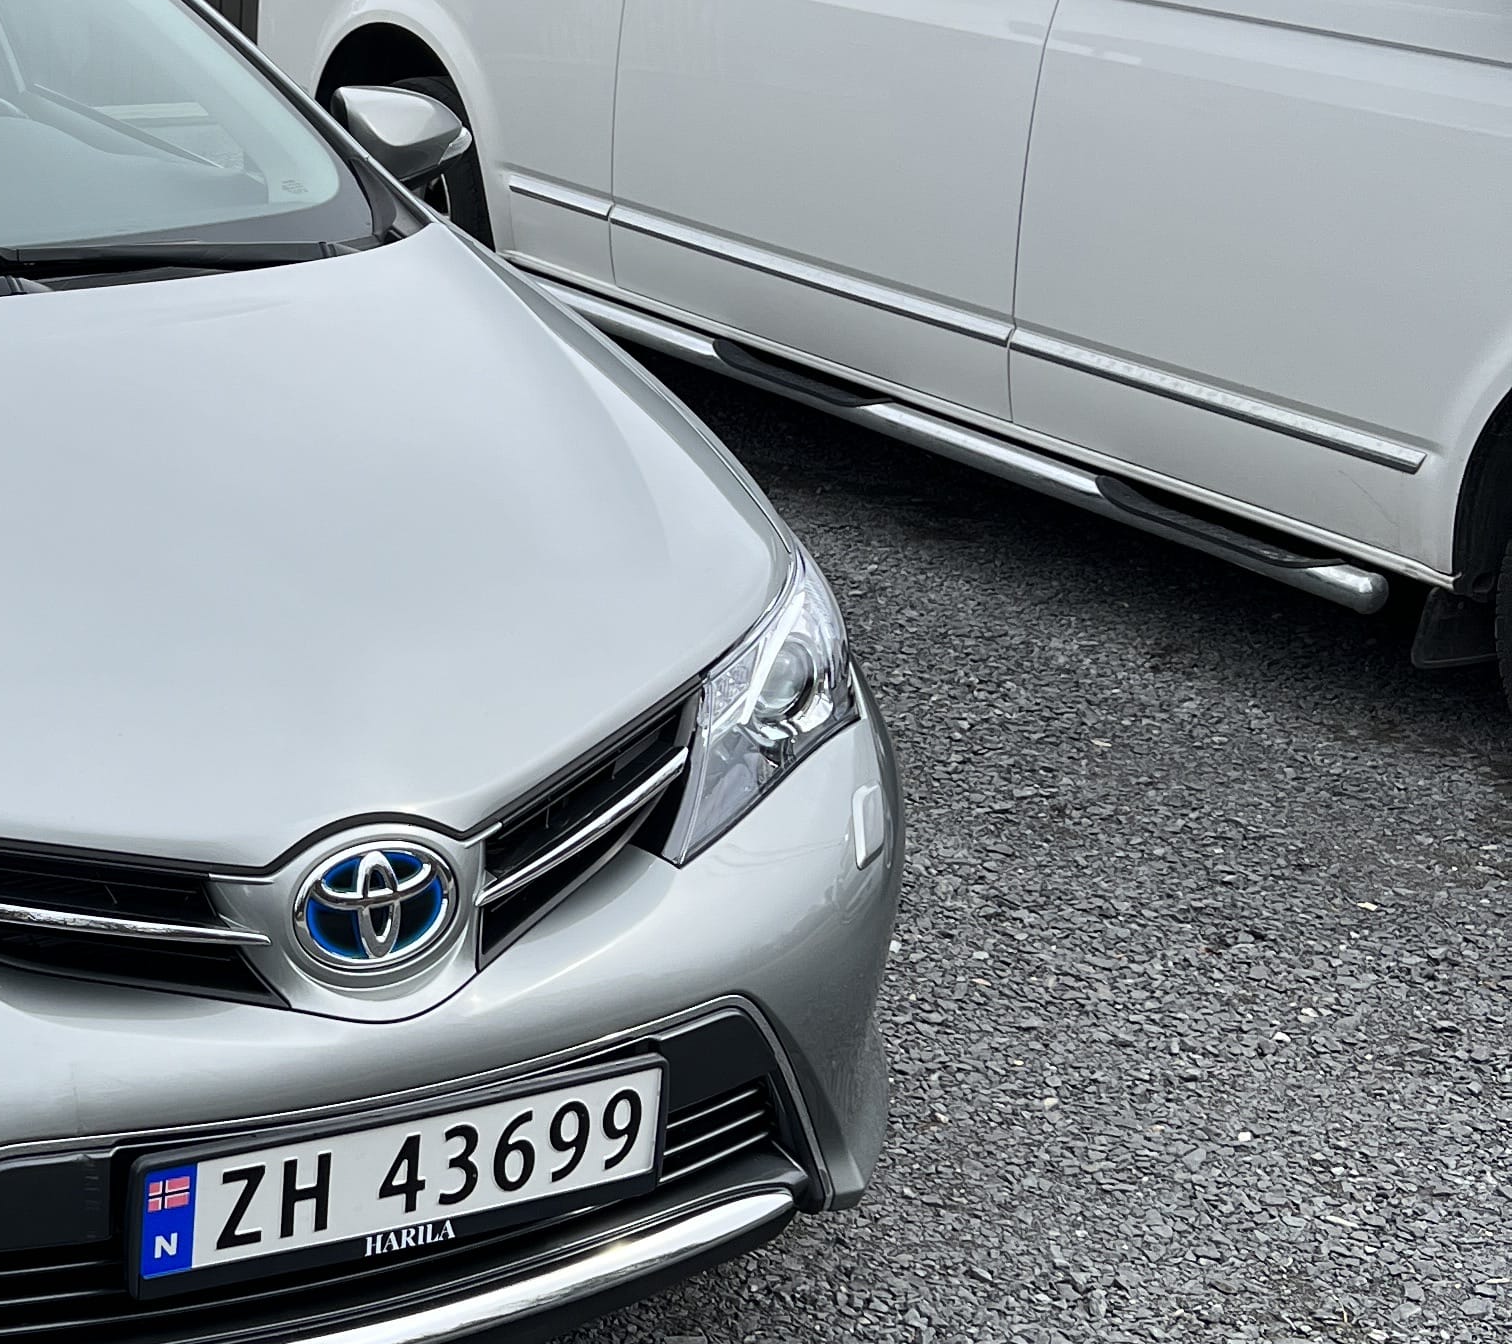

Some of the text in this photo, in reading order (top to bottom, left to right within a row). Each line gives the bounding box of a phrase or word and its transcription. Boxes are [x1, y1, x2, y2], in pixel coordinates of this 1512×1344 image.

[215, 1088, 643, 1251] ZH 43699
[153, 1222, 179, 1260] N
[364, 1219, 456, 1257] HARILA
